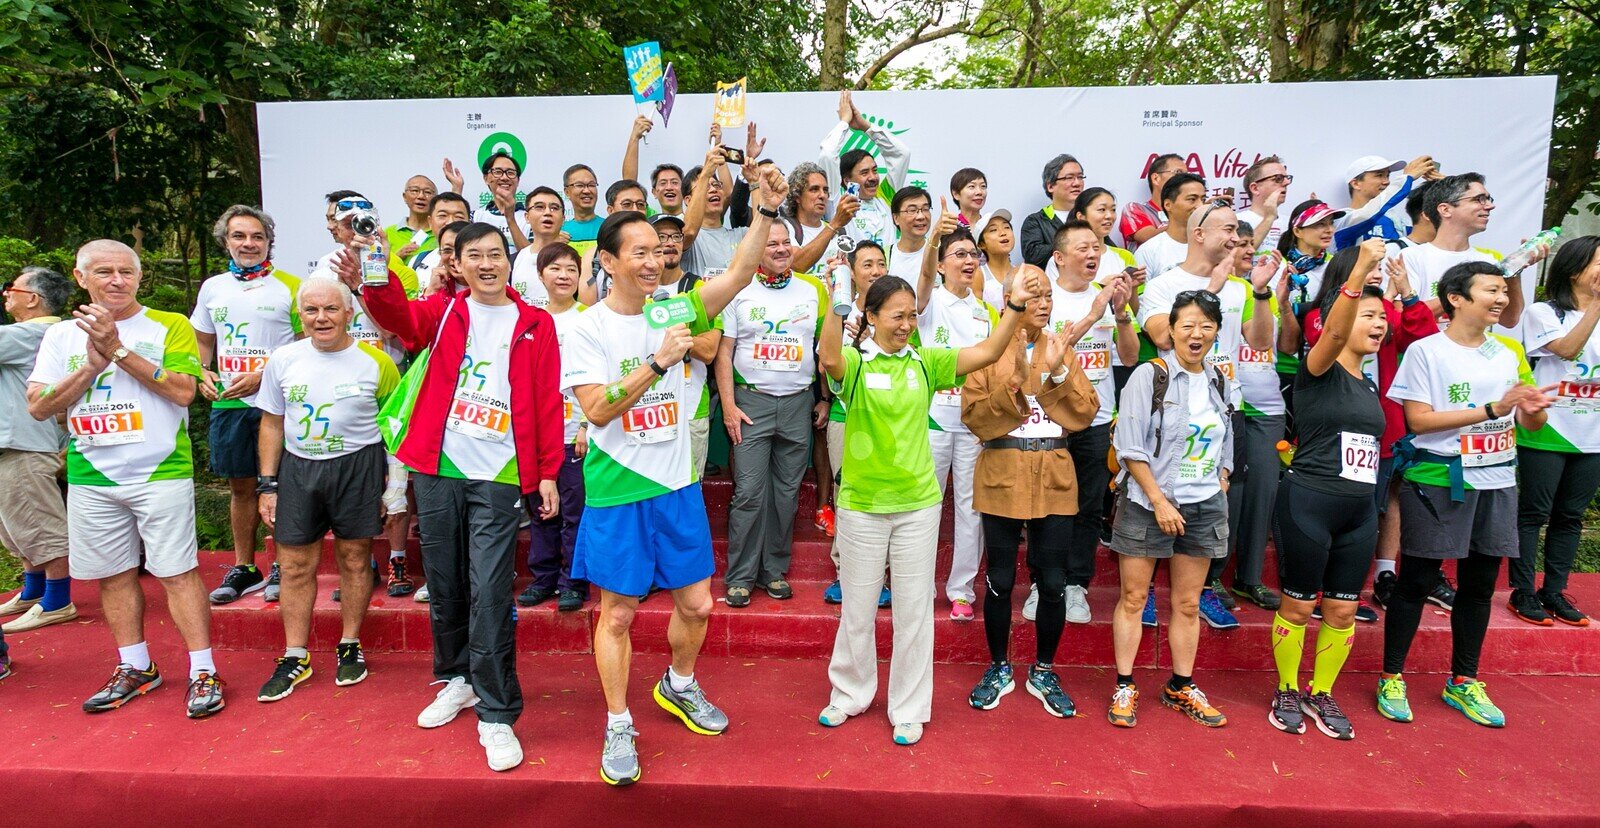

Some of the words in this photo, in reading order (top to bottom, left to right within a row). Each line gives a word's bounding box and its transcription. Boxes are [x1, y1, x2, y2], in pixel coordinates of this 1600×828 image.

[1142, 120, 1173, 128] Principal
[1175, 120, 1203, 128] Sponsor
[758, 344, 798, 360] L020
[1078, 353, 1106, 369] 023
[222, 357, 266, 372] L012
[288, 384, 308, 402] 毅
[660, 392, 675, 400] 2016
[1448, 382, 1472, 404] 毅
[490, 398, 508, 410] 2016
[296, 404, 334, 441] 35
[450, 400, 502, 430] L031
[628, 404, 677, 431] L001
[76, 414, 133, 435] L061
[325, 435, 344, 452] 者
[1182, 424, 1217, 462] 35
[1466, 430, 1514, 453] L066
